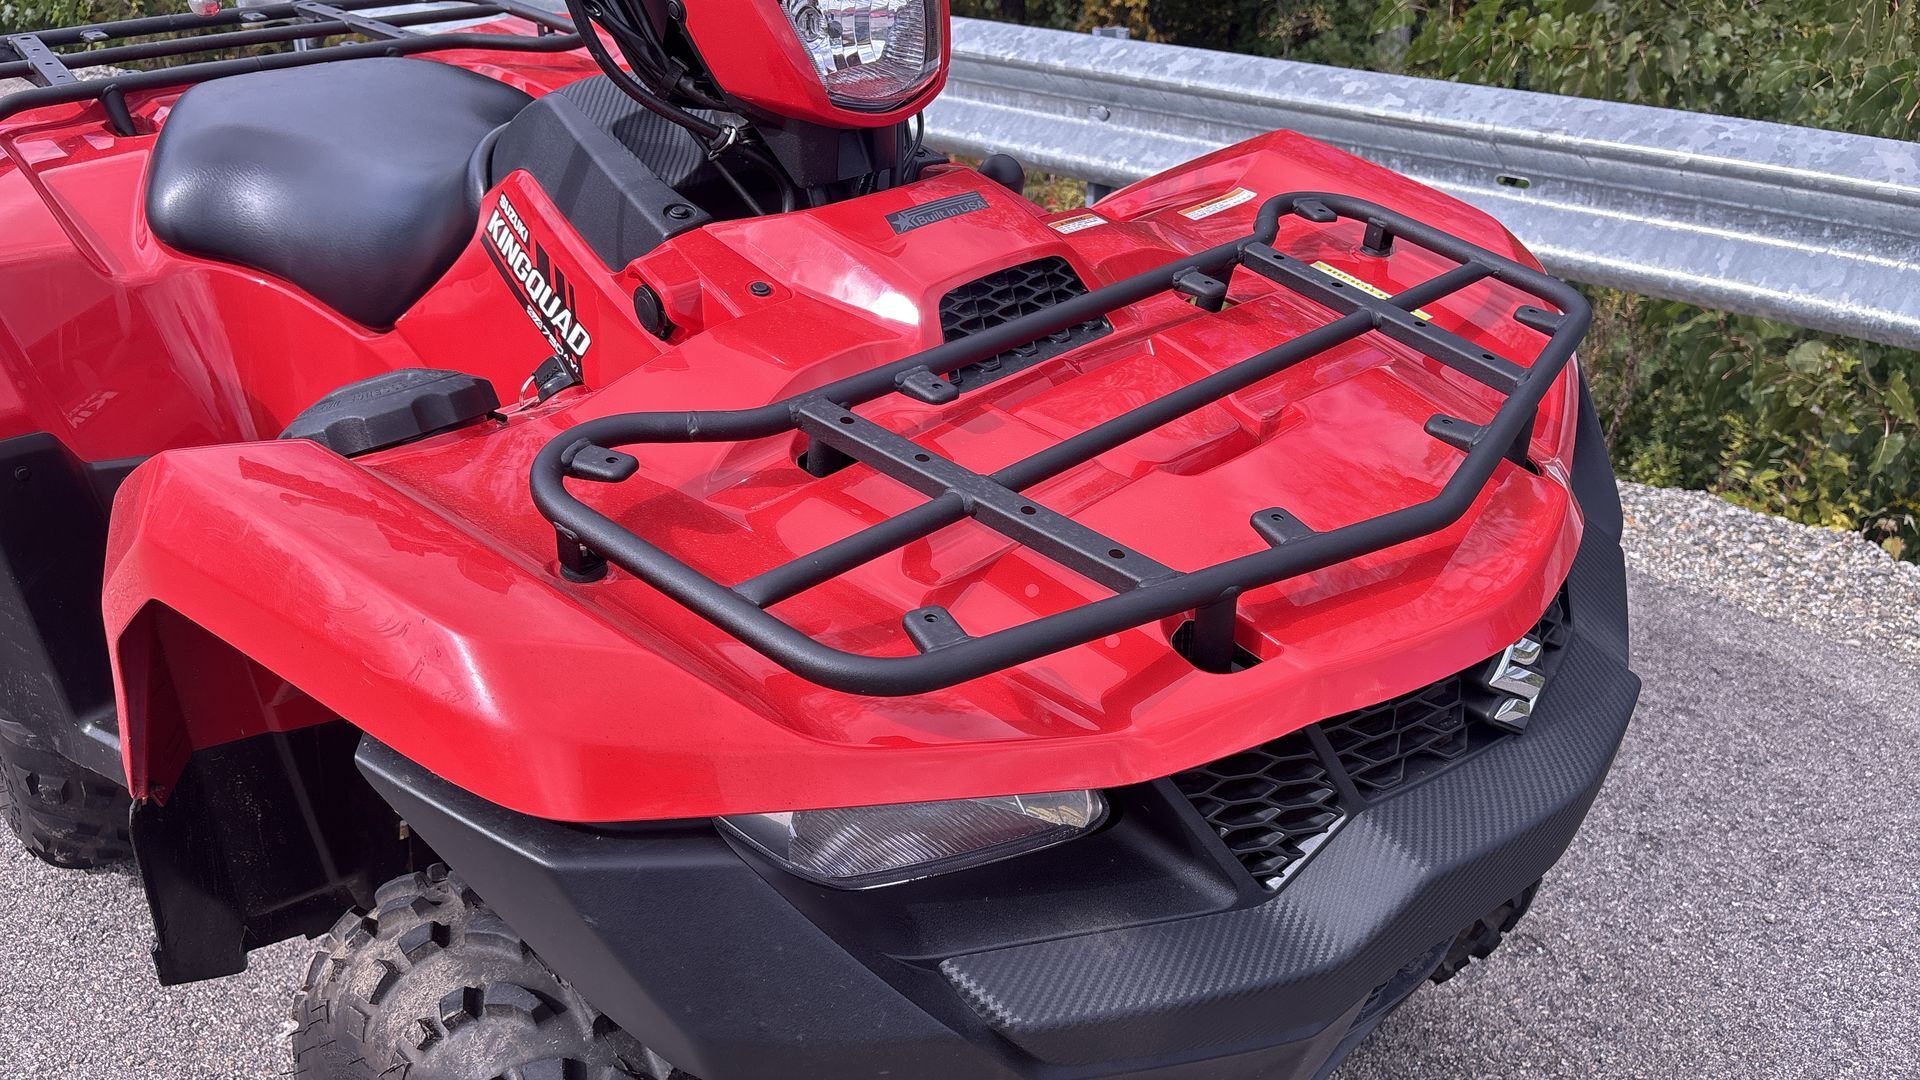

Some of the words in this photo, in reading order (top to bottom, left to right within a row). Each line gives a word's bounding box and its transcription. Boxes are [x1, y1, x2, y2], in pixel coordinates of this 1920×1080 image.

[499, 193, 529, 242] SUZUKI
[916, 209, 946, 225] Built
[947, 206, 960, 217] in
[960, 200, 989, 212] USA
[486, 208, 592, 356] KINGQUAD
